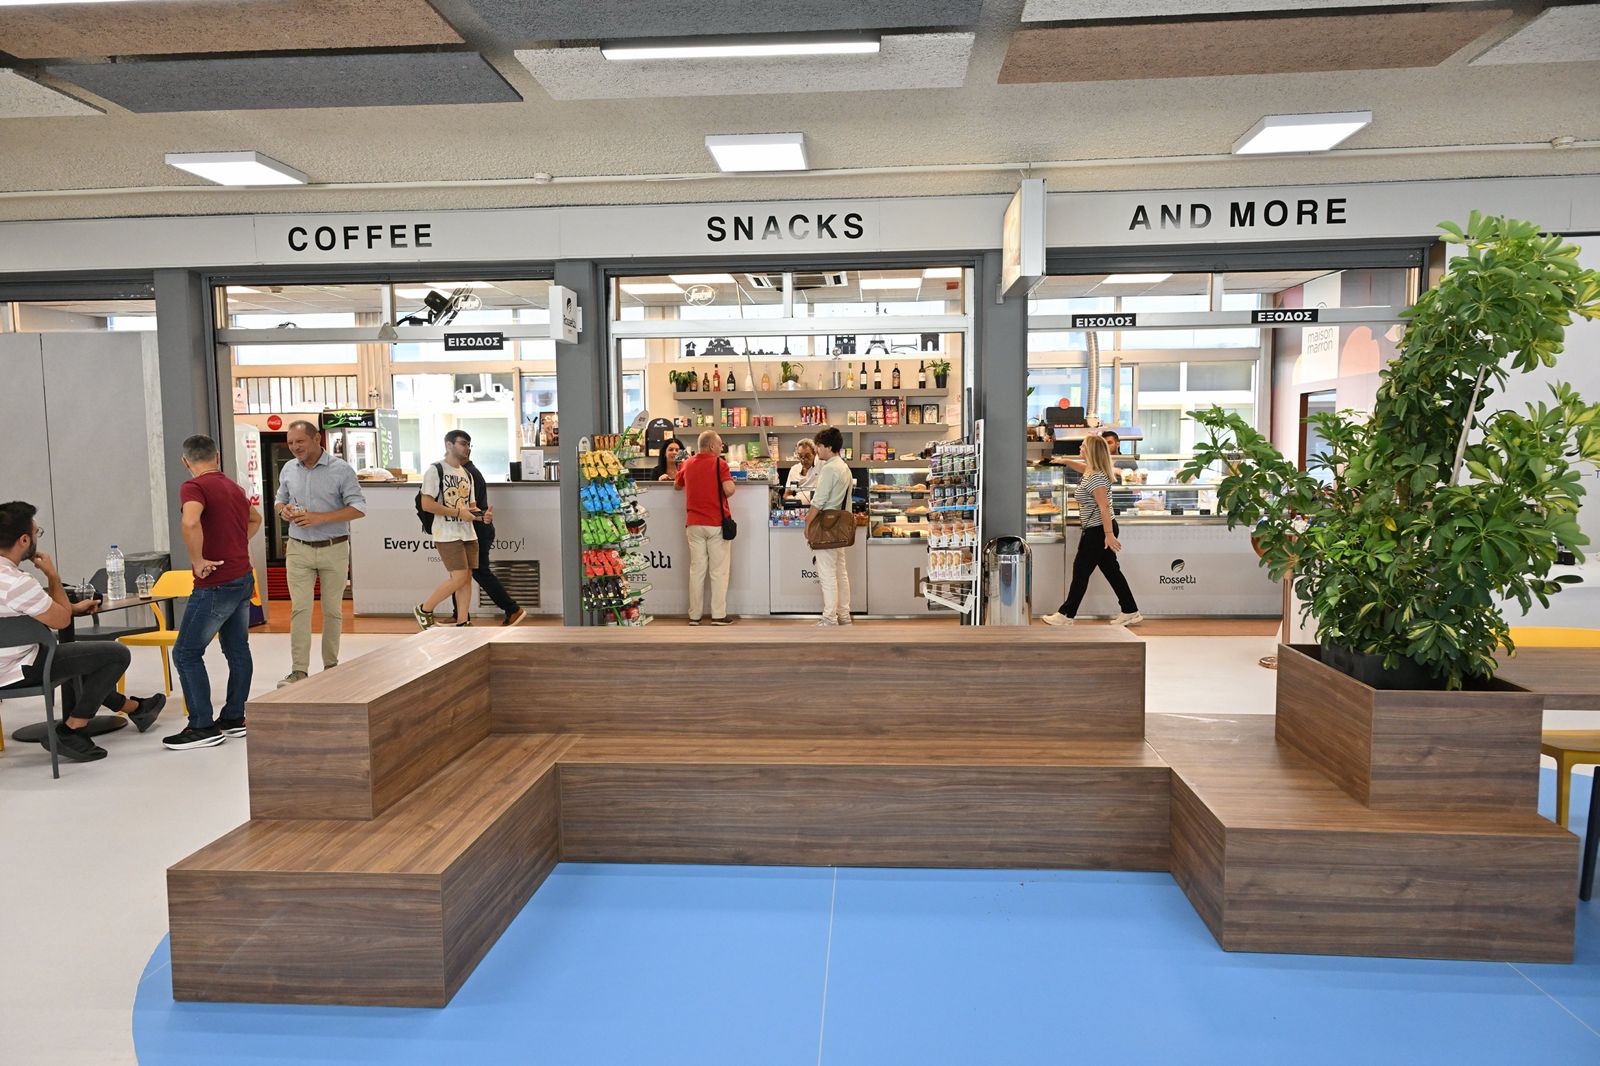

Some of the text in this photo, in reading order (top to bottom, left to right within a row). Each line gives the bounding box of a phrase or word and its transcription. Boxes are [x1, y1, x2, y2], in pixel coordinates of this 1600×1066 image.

[1129, 198, 1347, 230] AND MORE
[707, 213, 864, 242] SNACKS
[288, 223, 432, 251] COFFEE
[1075, 316, 1133, 328] ΕΙΣΟΔΟΣ
[1257, 311, 1312, 322] ΕΞΟΔΟΣ
[448, 336, 500, 347] ΕΙΣΟΔΟΣ
[1307, 327, 1334, 344] maison
[384, 537, 421, 553] Every
[422, 540, 437, 550] cu
[428, 555, 441, 563] ross
[801, 569, 819, 578] Ros
